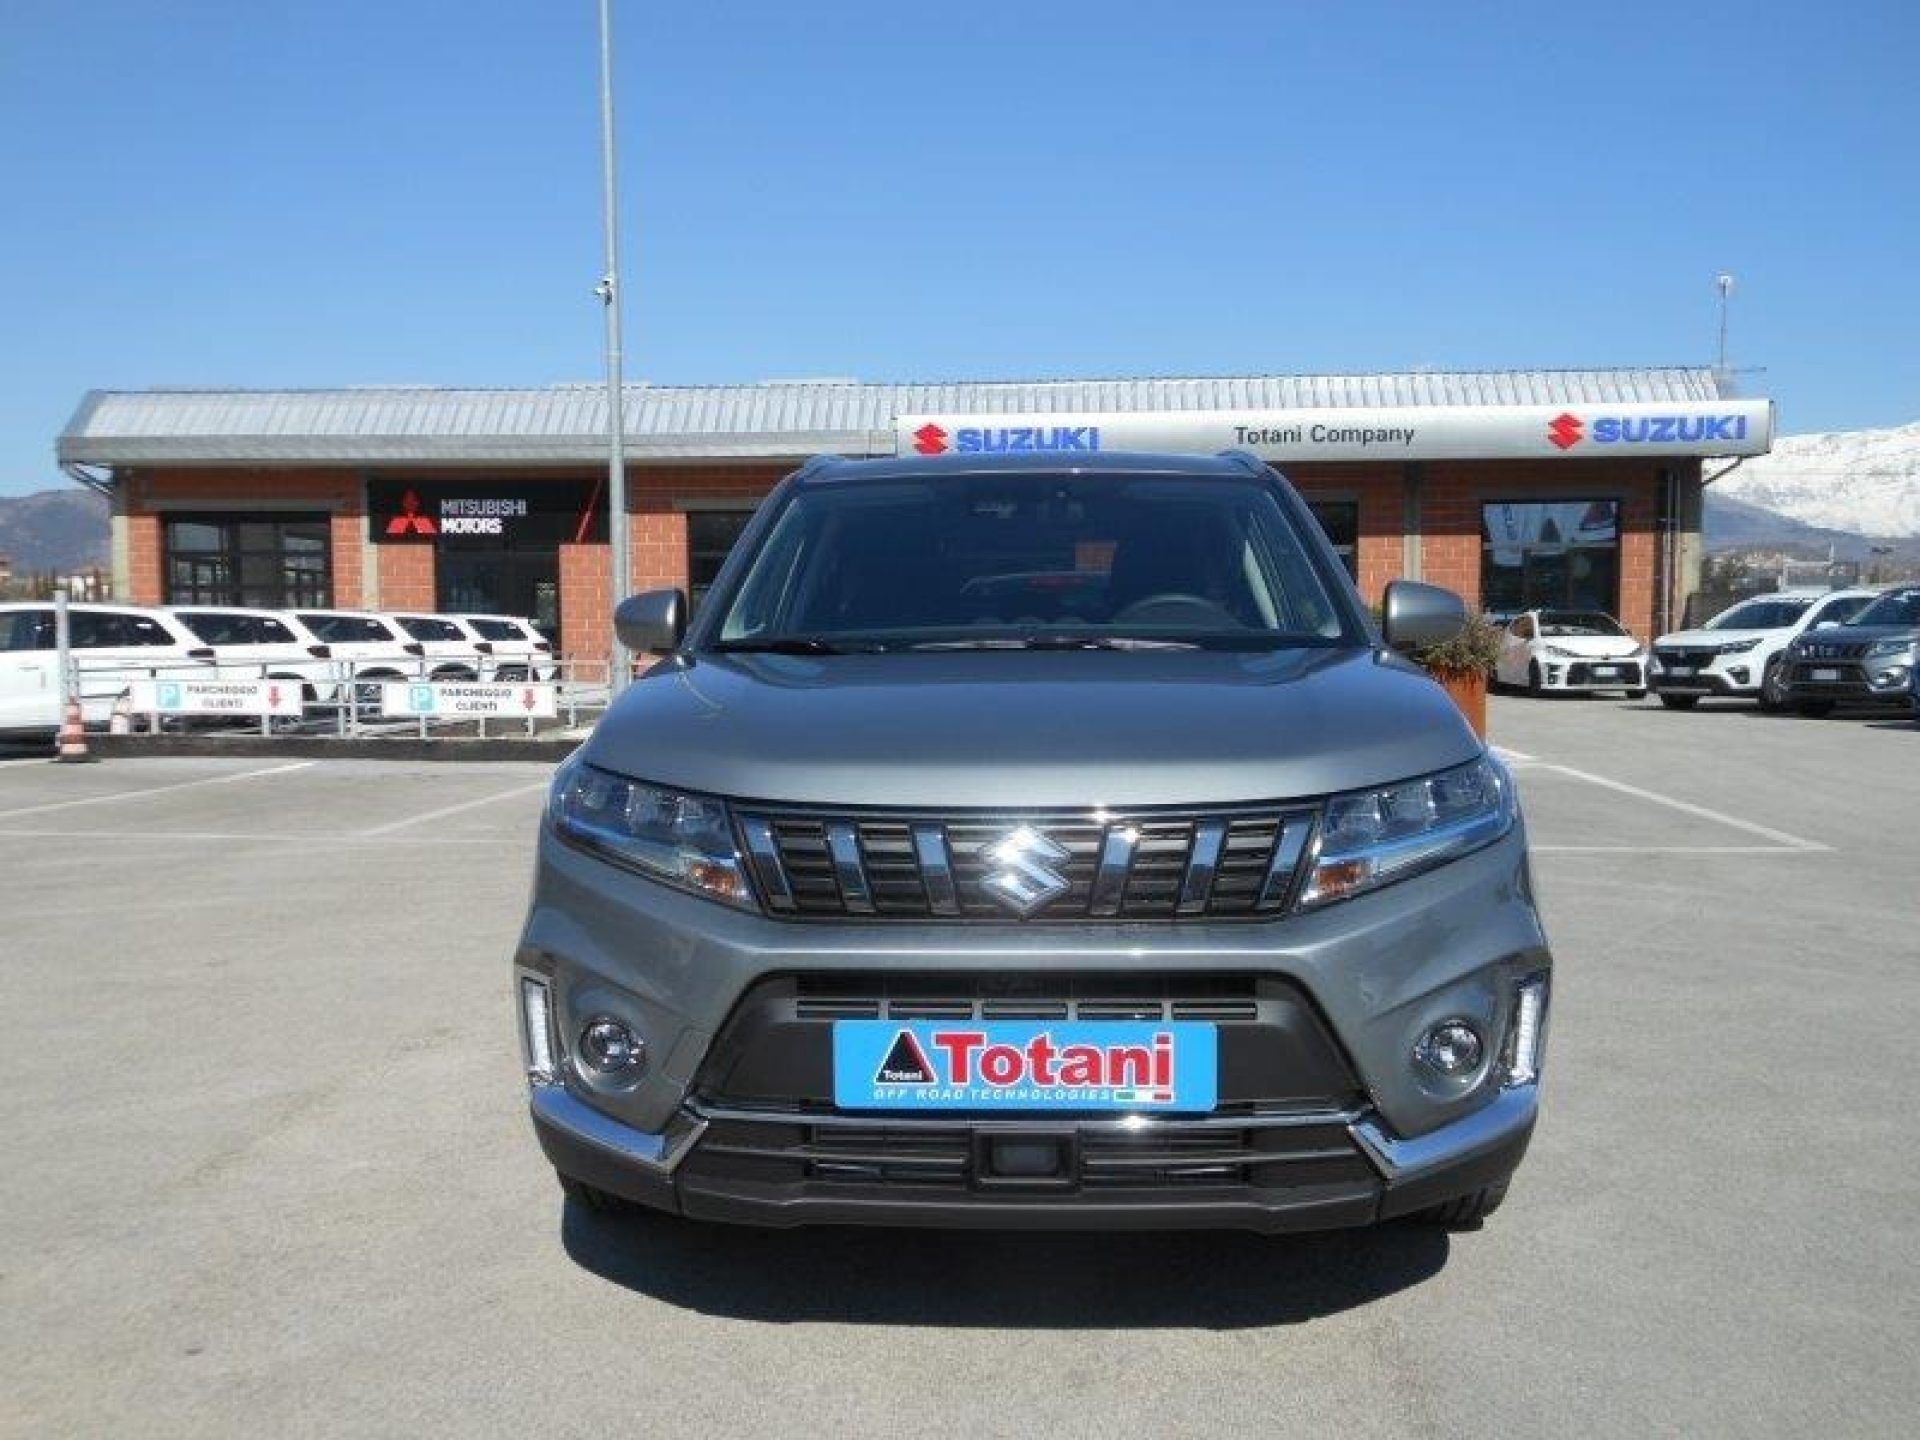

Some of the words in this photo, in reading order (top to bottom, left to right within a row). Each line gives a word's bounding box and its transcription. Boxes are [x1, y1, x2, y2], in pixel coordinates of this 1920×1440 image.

[1234, 425, 1301, 445] Totani
[1310, 424, 1415, 446] Company
[1592, 415, 1746, 442] SUZUKI
[957, 426, 1099, 451] SUZUKI
[441, 499, 527, 516] MITSUBISHI
[441, 518, 502, 534] MOTORS
[186, 685, 258, 696] PARCHEGGIO
[440, 688, 512, 698] PARCHEGGIO
[202, 698, 243, 708] CLIENTI
[455, 701, 498, 711] CLIENTI
[931, 1031, 1174, 1087] Totani
[883, 1069, 923, 1081] Totani
[874, 1088, 907, 1100] OFF
[916, 1088, 963, 1100] ROAD
[970, 1088, 1110, 1100] TECHNOLOGIES
